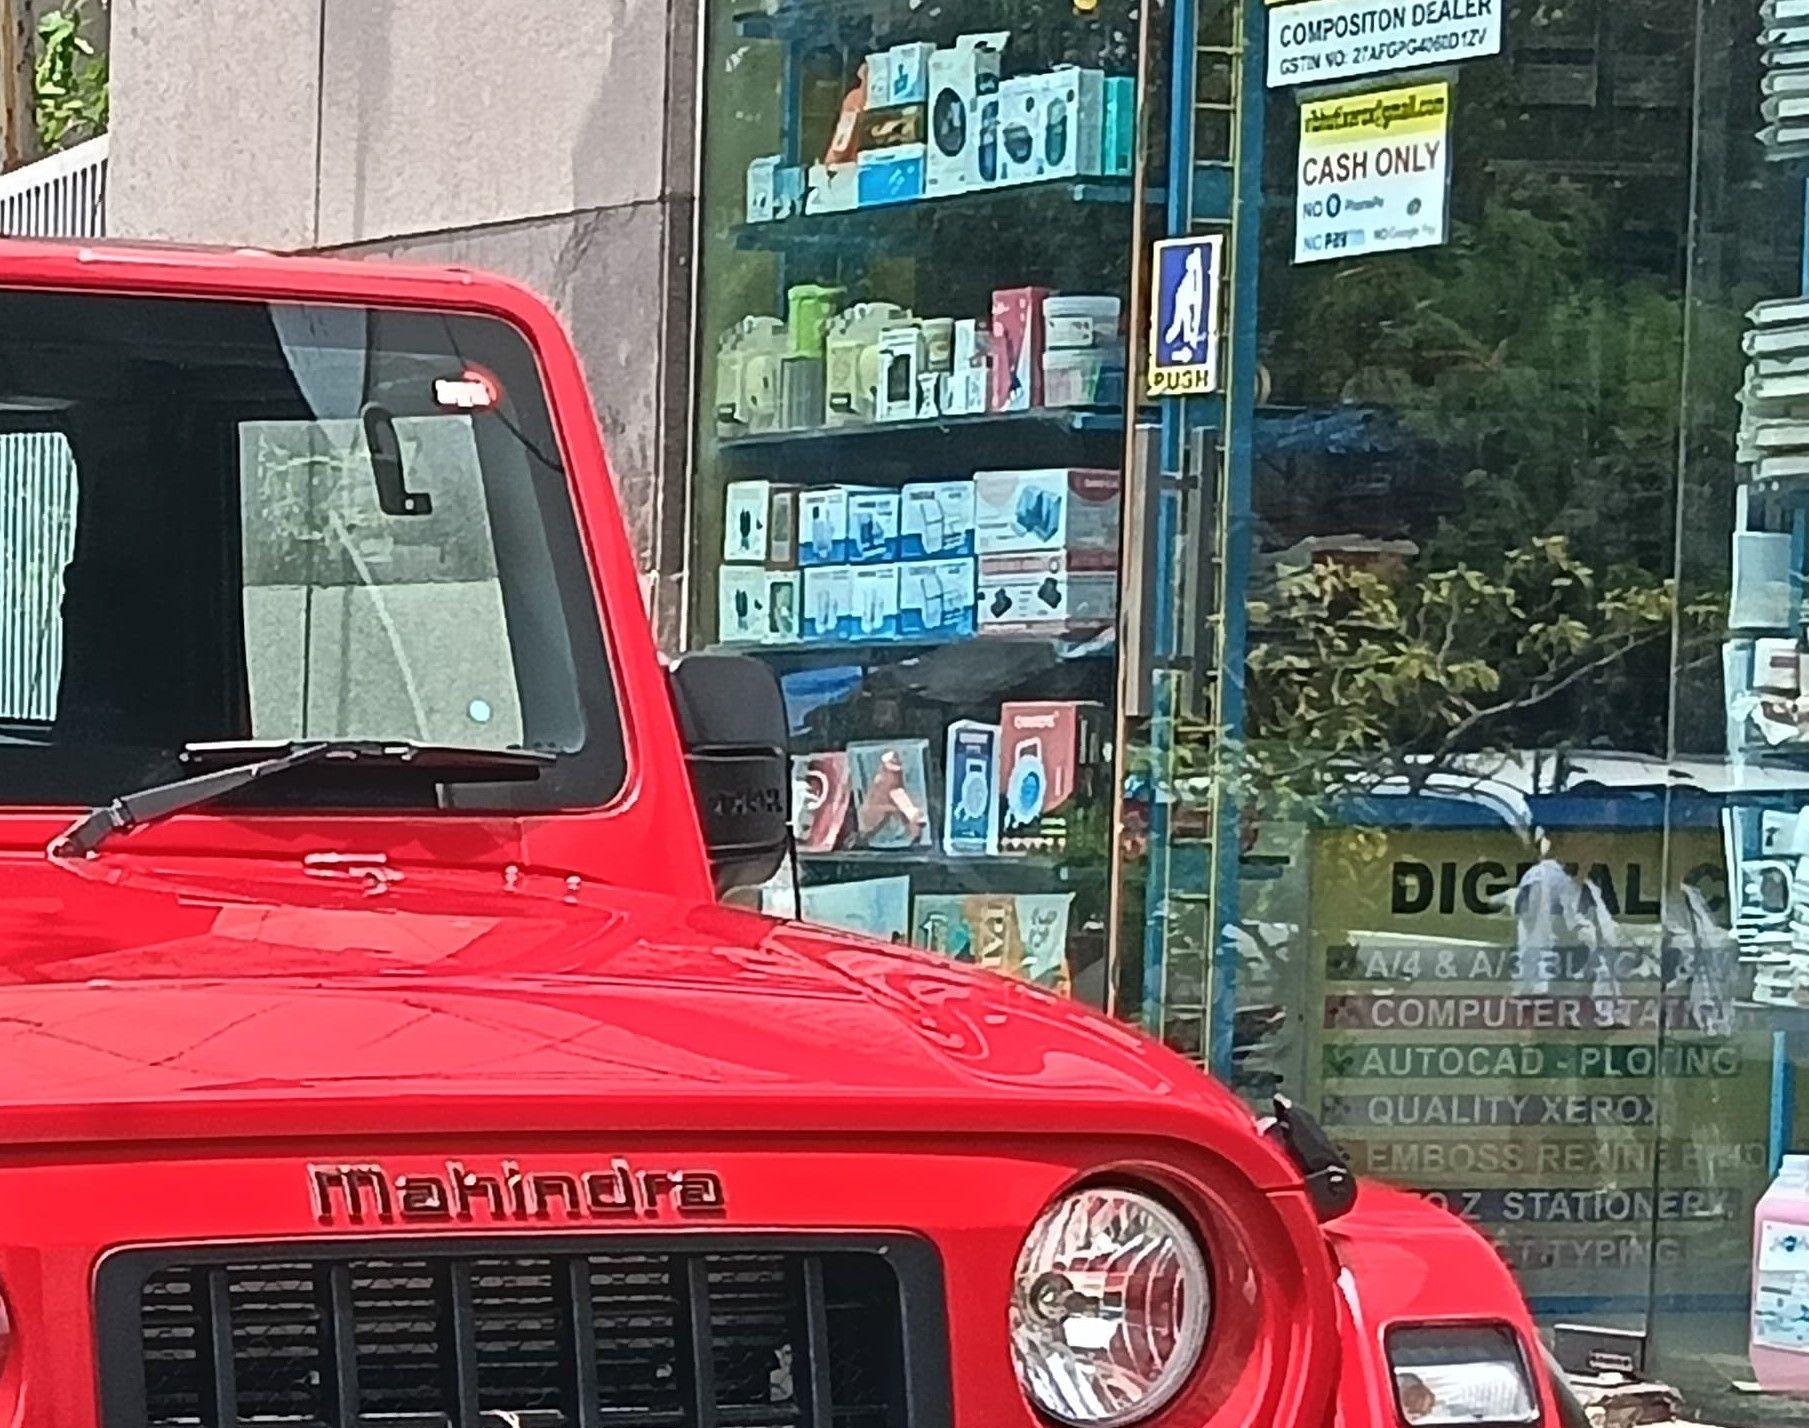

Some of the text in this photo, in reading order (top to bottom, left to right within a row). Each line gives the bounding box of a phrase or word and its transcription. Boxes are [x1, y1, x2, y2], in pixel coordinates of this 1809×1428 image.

[1279, 0, 1492, 47] COMPOSITON DEALER
[1303, 140, 1440, 187] CASH ONLY
[1153, 370, 1209, 390] PUSH
[1371, 998, 1582, 1028] COMPUTER
[1361, 1046, 1544, 1076] AUTOCAD
[1367, 1096, 1531, 1126] QUALITY
[1367, 1144, 1525, 1173] EMBOSS
[306, 1158, 728, 1225] Mahindra
